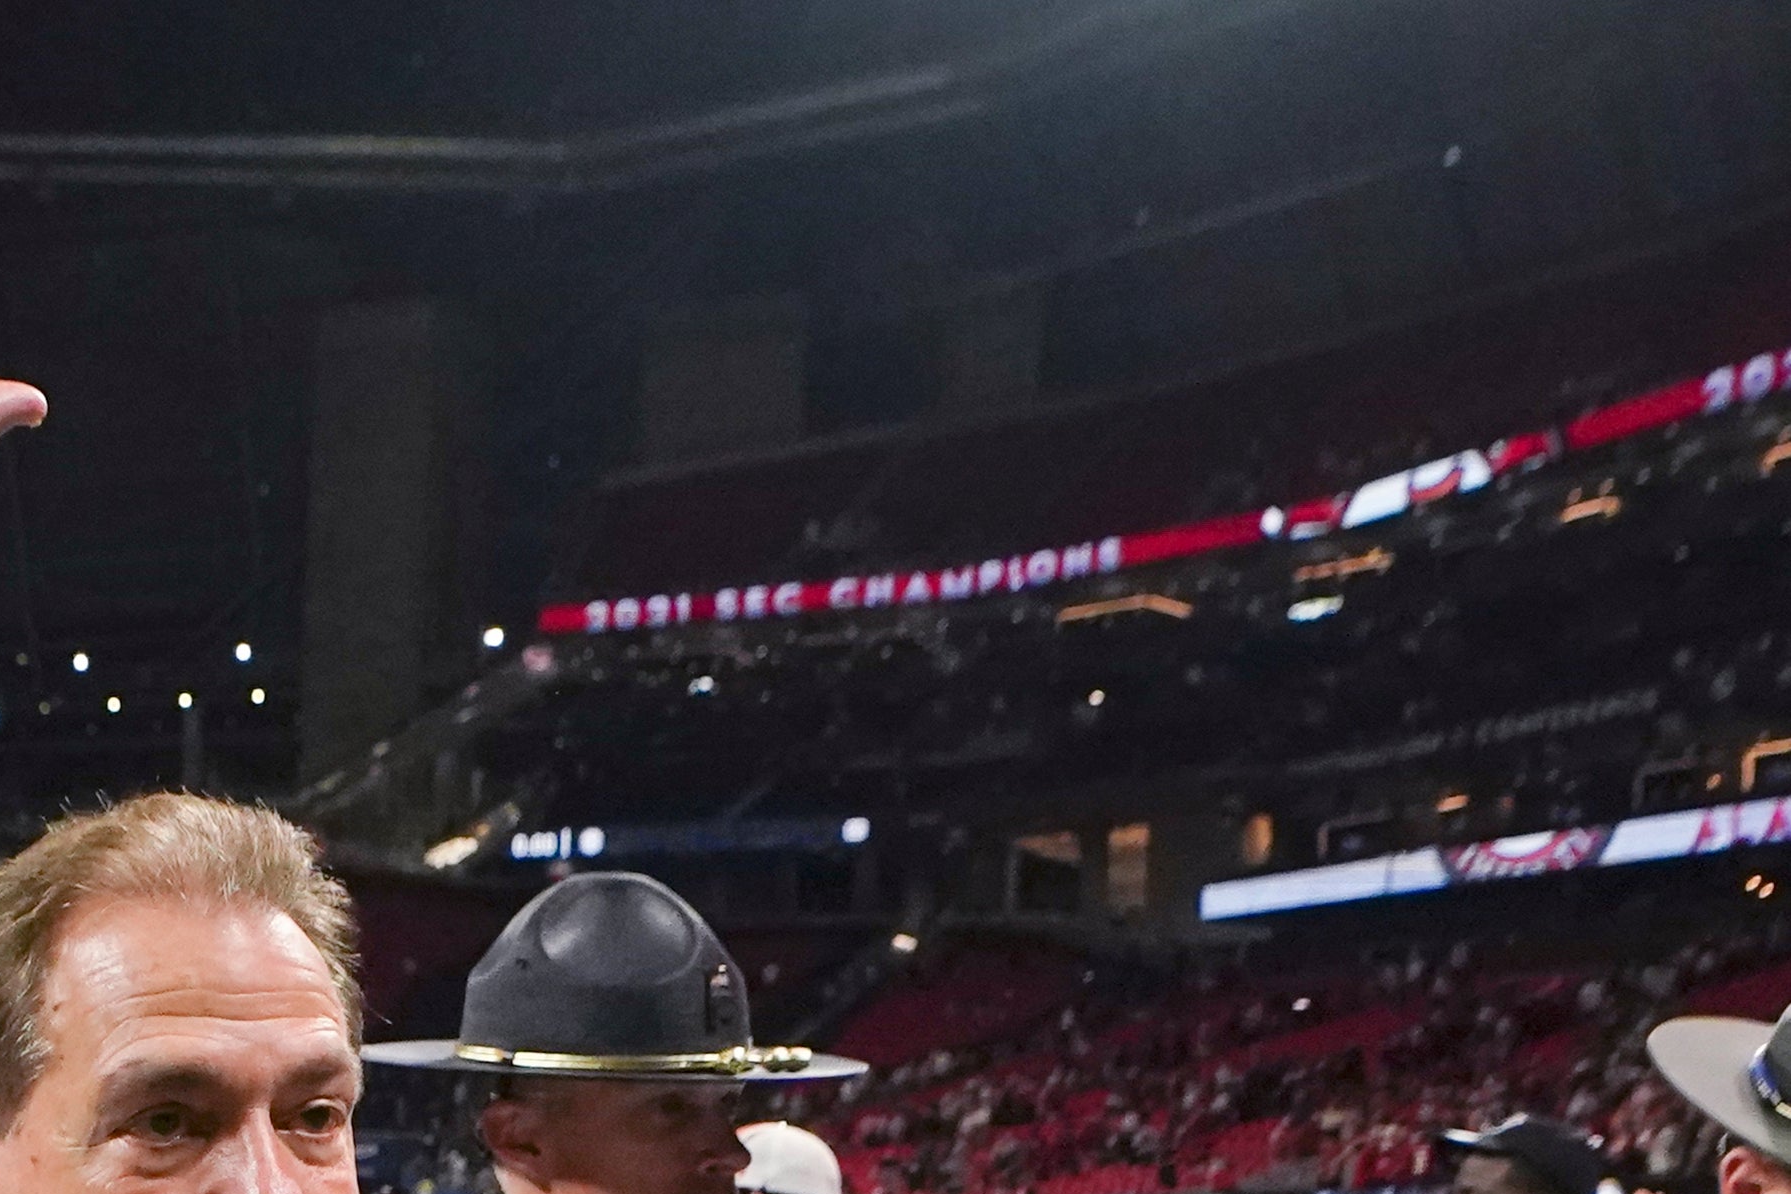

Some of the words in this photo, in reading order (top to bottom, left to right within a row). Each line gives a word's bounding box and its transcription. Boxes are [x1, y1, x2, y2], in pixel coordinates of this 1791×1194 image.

[585, 592, 692, 634] 2021
[714, 586, 802, 622] SEC
[828, 535, 1120, 611] CHAMPIONS
